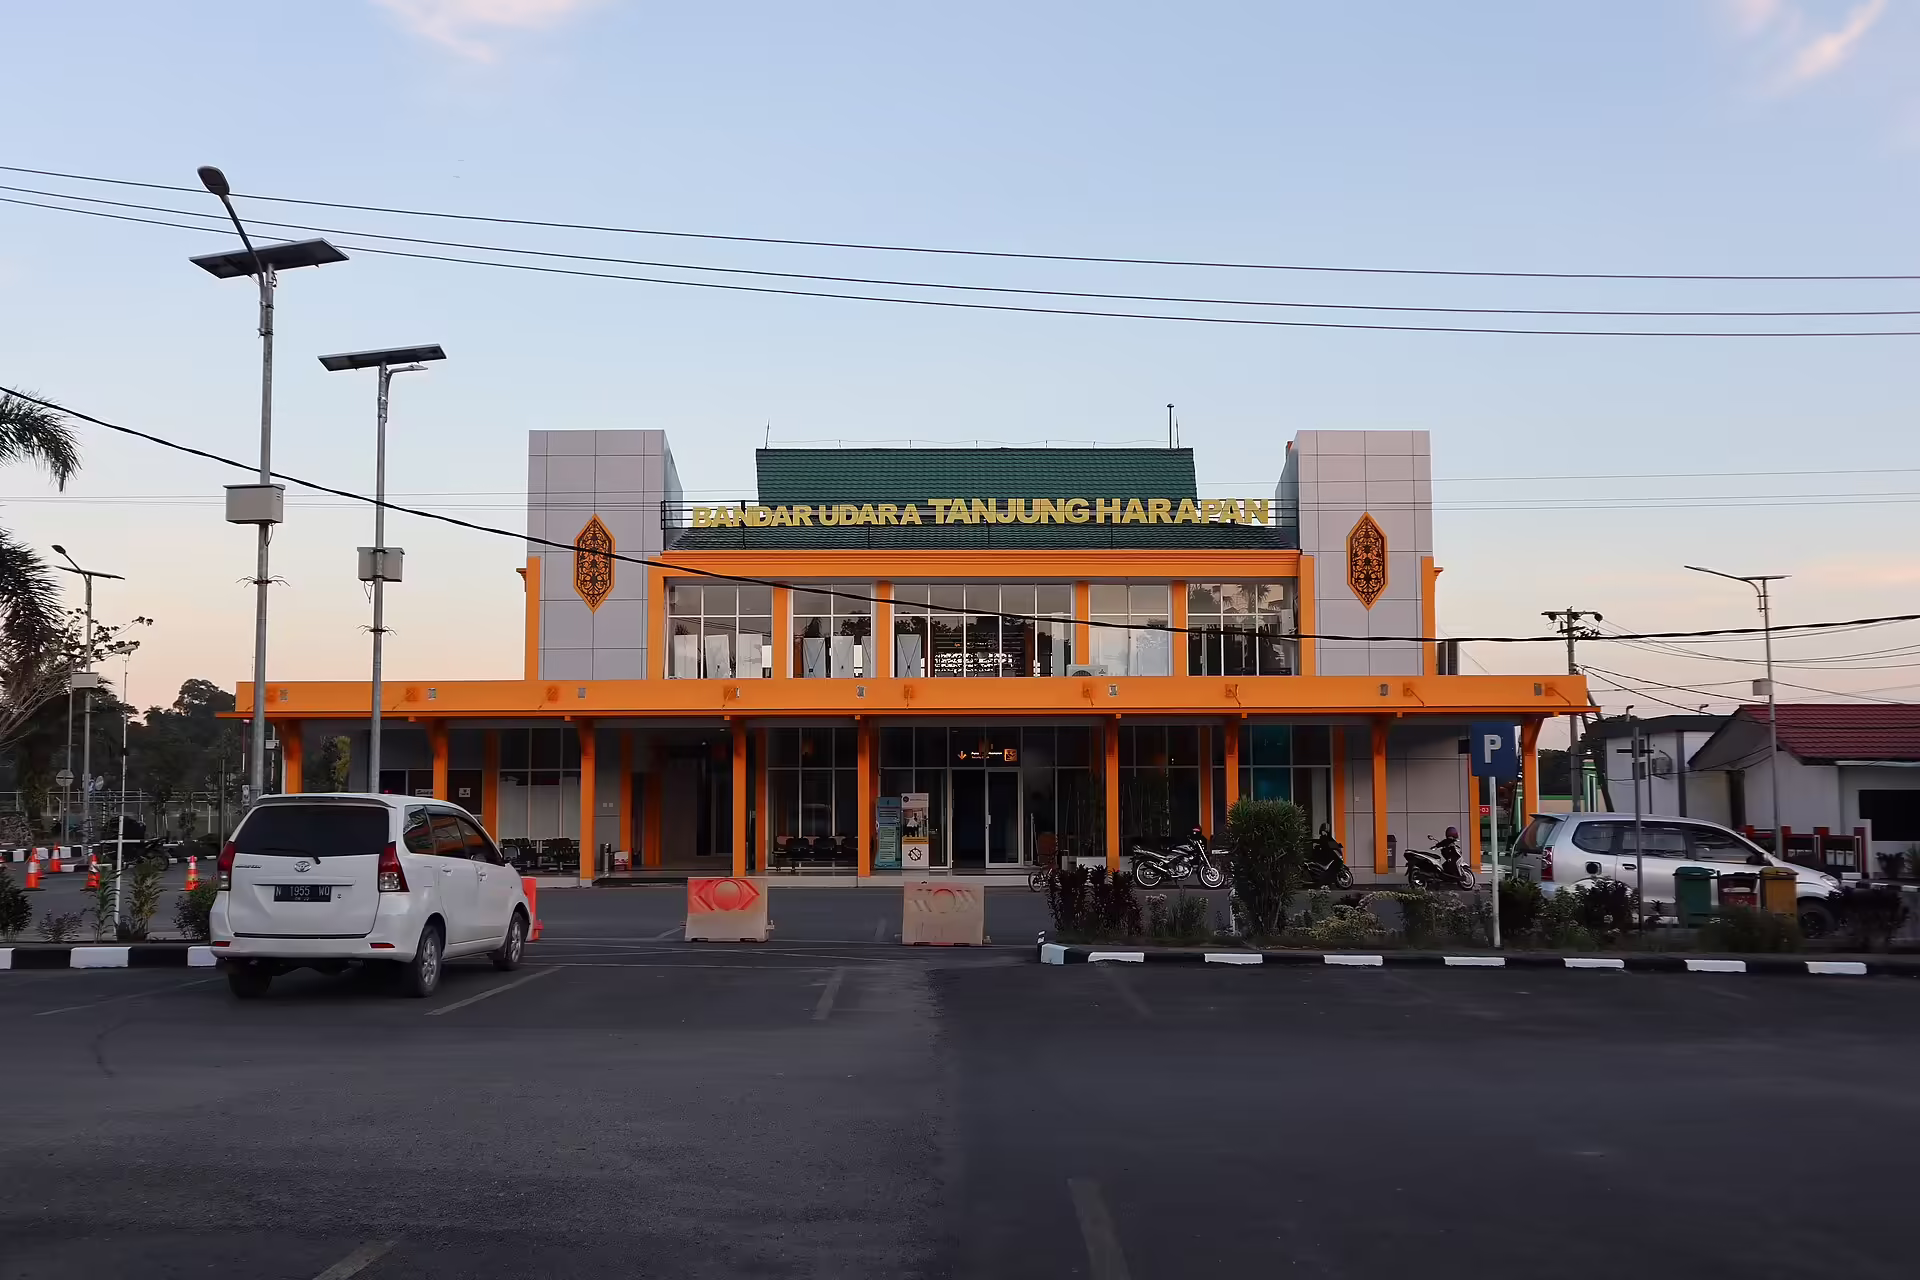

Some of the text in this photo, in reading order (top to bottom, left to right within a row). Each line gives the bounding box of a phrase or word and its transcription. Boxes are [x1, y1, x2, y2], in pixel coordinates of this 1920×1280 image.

[692, 498, 1269, 528] BANDAR UDARA TANJUNG HARAPAN
[1484, 734, 1502, 764] P
[275, 886, 282, 897] N
[290, 885, 310, 897] 1955
